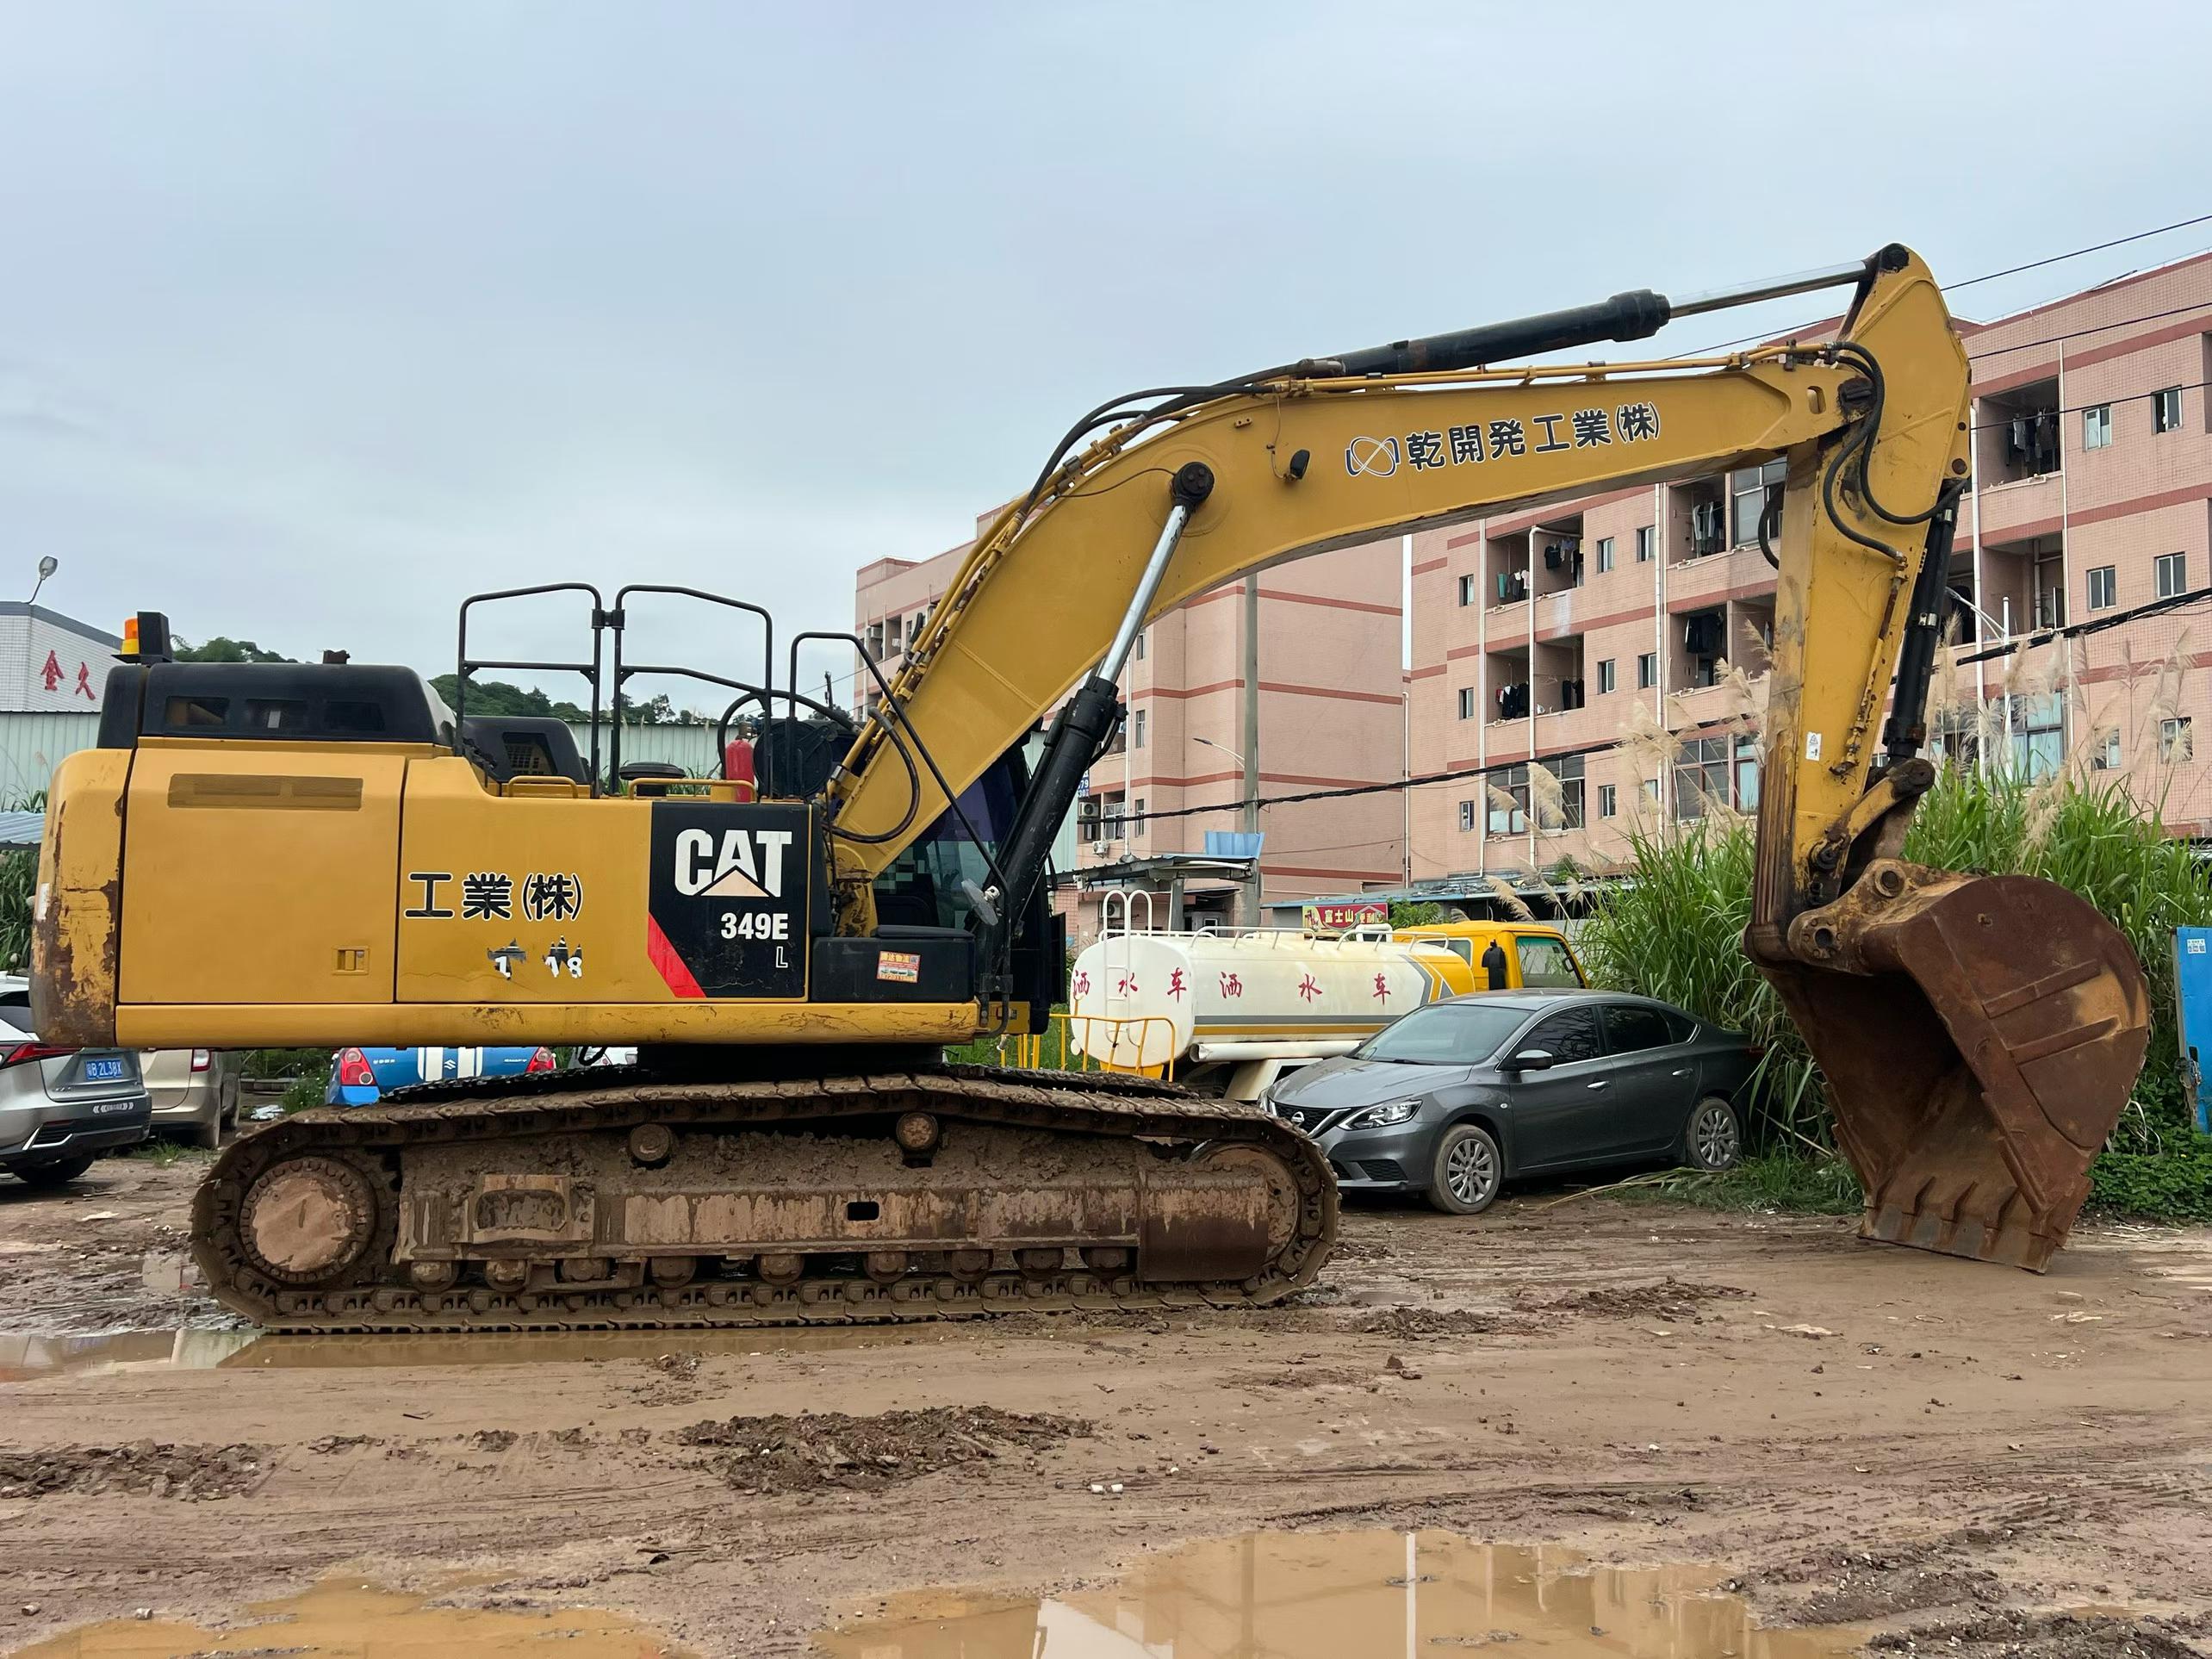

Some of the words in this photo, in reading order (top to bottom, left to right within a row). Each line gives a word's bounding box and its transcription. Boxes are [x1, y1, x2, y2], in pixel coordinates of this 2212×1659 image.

[674, 829, 792, 898] CAT
[720, 912, 789, 941] 349E
[775, 946, 789, 969] L
